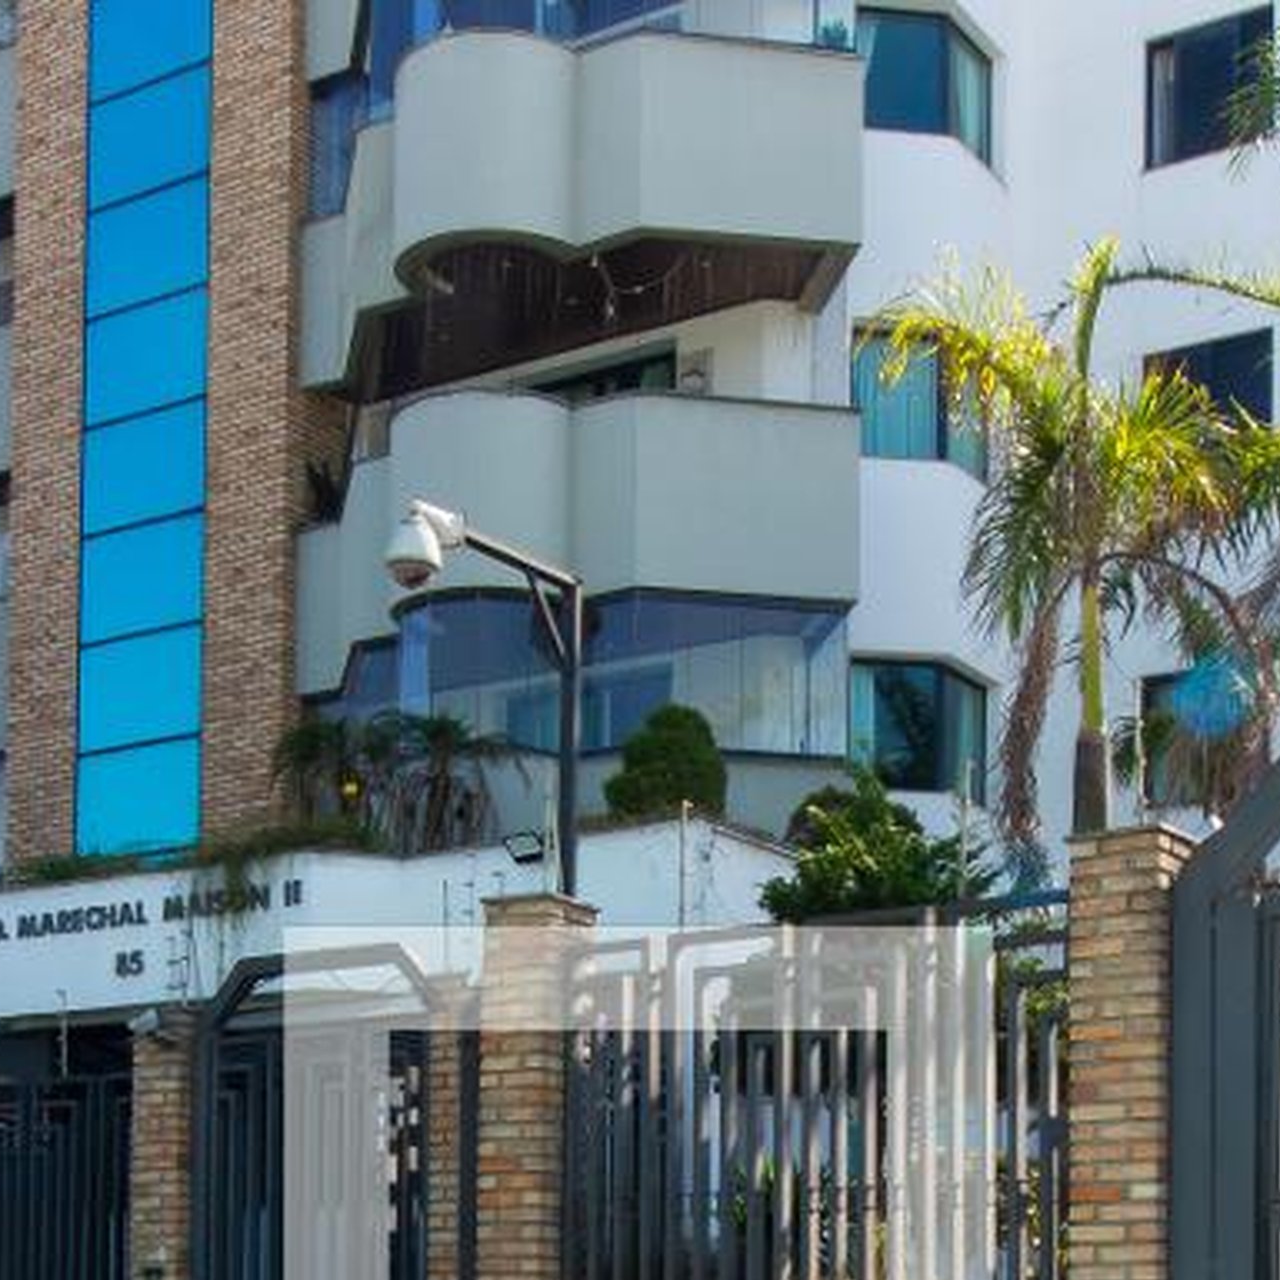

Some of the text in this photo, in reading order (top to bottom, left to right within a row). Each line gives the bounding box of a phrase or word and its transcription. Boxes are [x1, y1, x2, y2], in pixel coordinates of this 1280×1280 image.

[17, 901, 149, 939] MARECHAL
[163, 883, 271, 922] MAISN
[284, 878, 303, 907] II
[116, 950, 144, 978] 85
